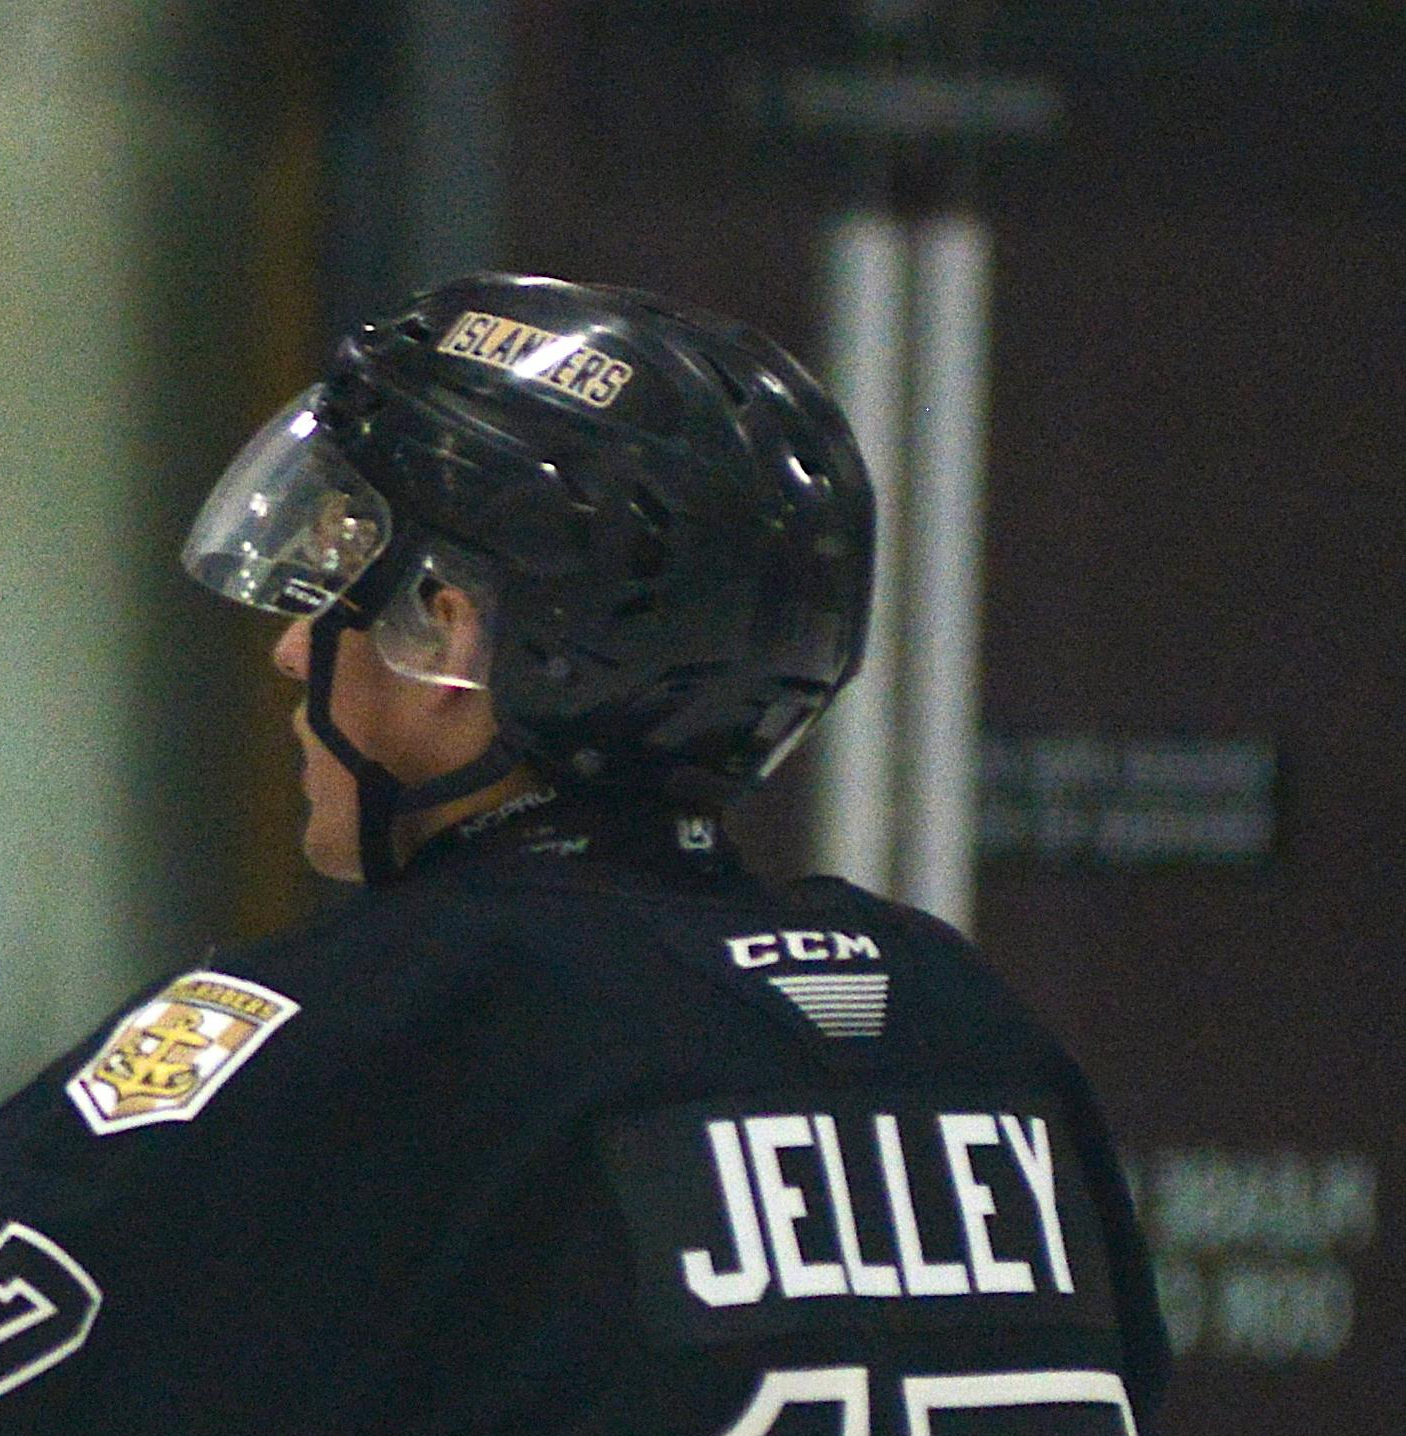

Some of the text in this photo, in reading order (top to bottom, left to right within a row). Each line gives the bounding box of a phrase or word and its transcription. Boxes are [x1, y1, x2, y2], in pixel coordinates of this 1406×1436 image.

[444, 314, 631, 406] ISLANERS
[724, 929, 881, 970] CCM
[680, 1112, 1076, 1308] JELLEY
